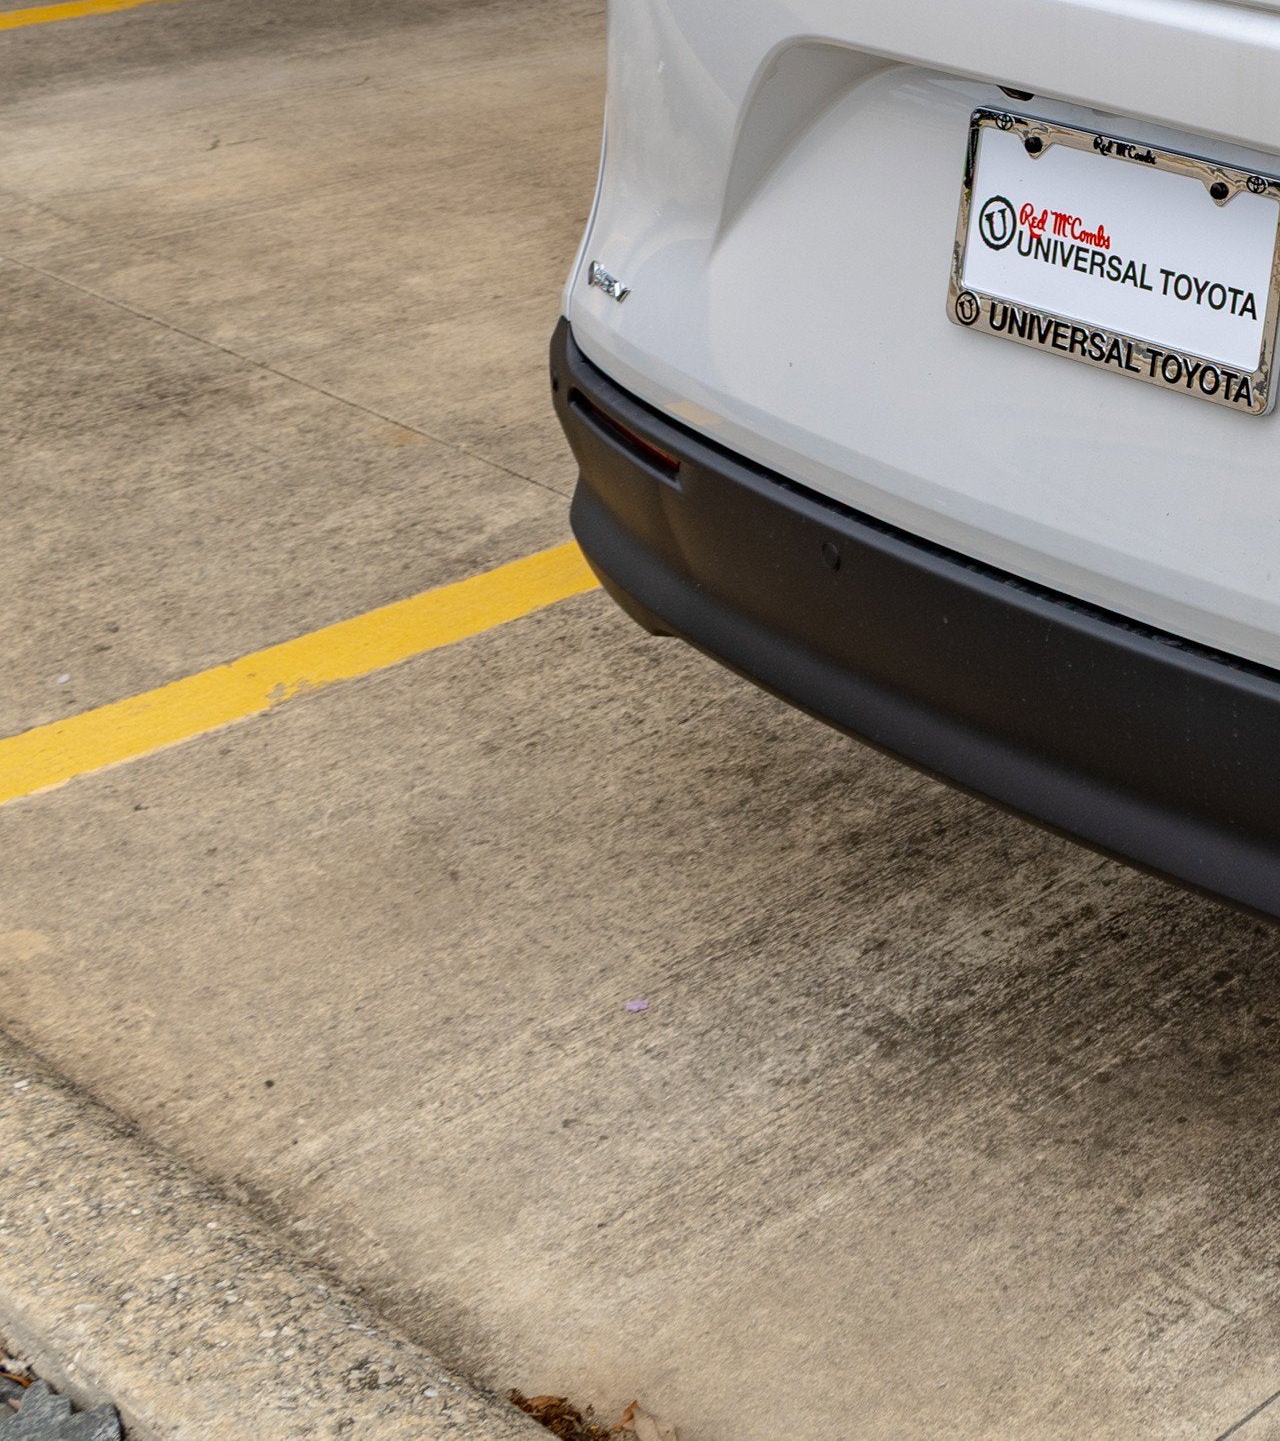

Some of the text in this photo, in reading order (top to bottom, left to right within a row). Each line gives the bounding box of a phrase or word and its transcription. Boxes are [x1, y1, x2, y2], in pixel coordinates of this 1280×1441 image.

[1019, 203, 1111, 250] Red McCombs
[1017, 230, 1258, 321] UNIVERSAL TOYOTA
[989, 301, 1255, 407] UNIVERSAL TOYOTA
